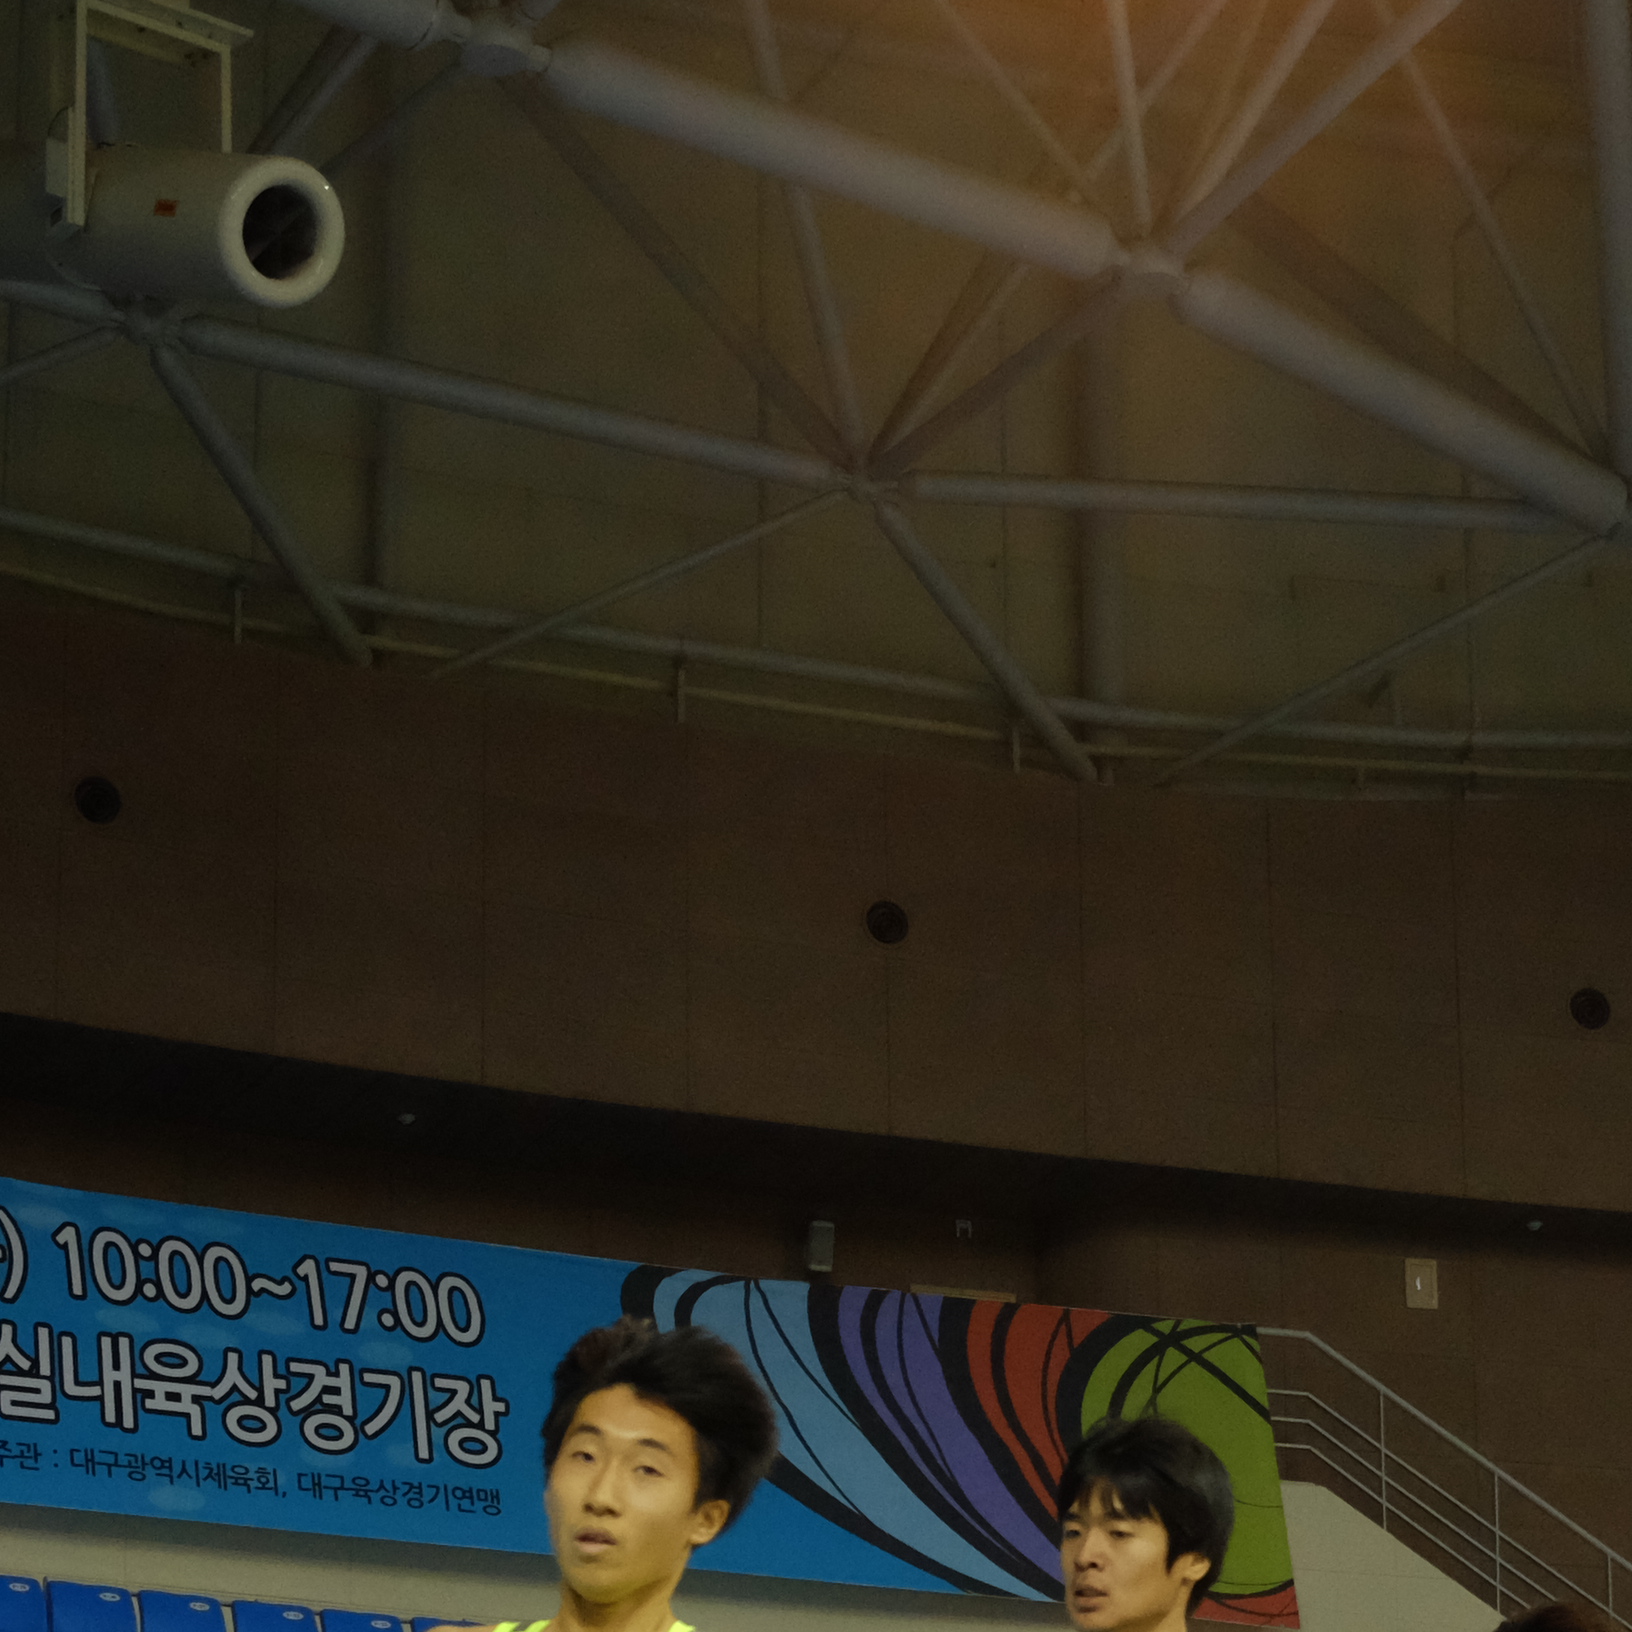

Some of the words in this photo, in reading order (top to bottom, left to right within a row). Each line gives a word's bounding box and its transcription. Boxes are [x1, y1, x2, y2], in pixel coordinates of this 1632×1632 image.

[52, 1221, 484, 1349] 10:00~17:00
[69, 1448, 287, 1499] 대구광역시체육회,
[298, 1471, 502, 1517] 대구육상경기연맹
